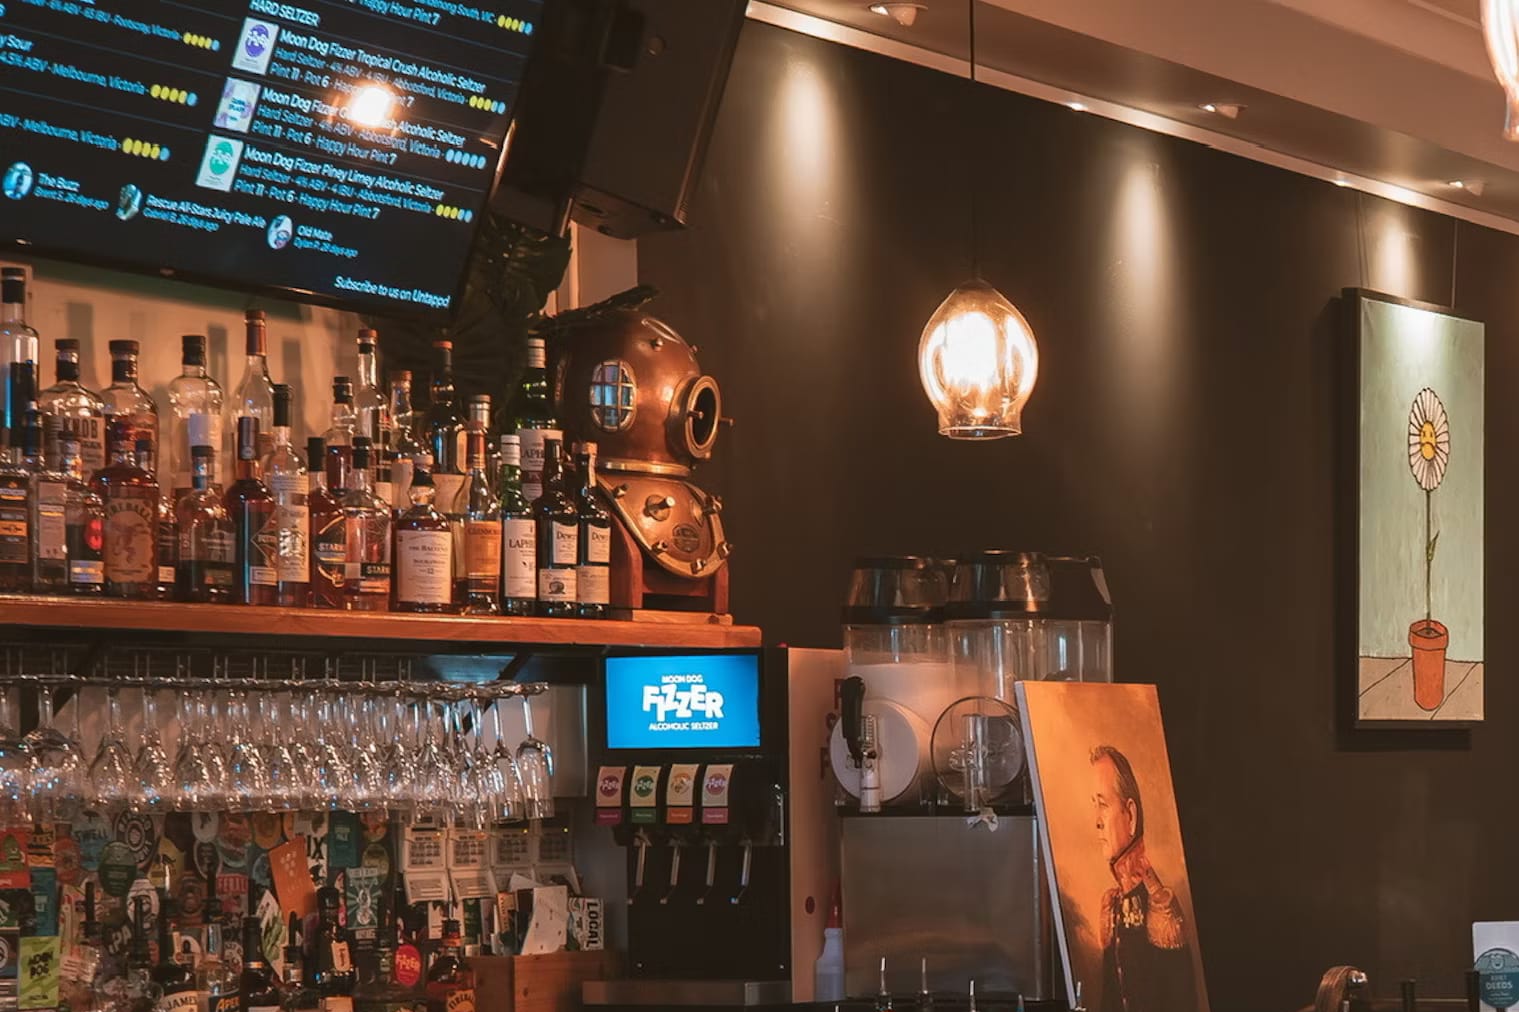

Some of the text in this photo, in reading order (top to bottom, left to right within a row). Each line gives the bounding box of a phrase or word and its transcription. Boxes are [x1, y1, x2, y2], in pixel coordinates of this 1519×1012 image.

[249, 0, 321, 26] HARD SELTZER
[389, 3, 413, 18] Hour
[413, 8, 431, 24] Pint
[431, 13, 440, 26] 7
[274, 47, 297, 61] Hard
[296, 52, 327, 69] Seltzer
[437, 87, 466, 104] Victoria
[280, 29, 307, 49] Moon
[307, 36, 330, 57] Dog
[329, 42, 357, 60] Fizzer
[357, 48, 392, 71] Tropical
[392, 58, 419, 77] Crush
[418, 66, 457, 88] Alcoholic
[457, 76, 487, 95] Seltzer
[108, 76, 145, 95] Victoria
[270, 61, 291, 79] Pint
[303, 70, 322, 86] Pot
[320, 76, 331, 88] 6
[406, 96, 415, 108] 7
[257, 104, 282, 120] Hard
[281, 109, 314, 128] Seltzer
[409, 139, 441, 159] Victoria
[262, 87, 290, 106] Moon
[290, 94, 312, 113] Dog
[311, 99, 339, 117] Fizzer
[397, 121, 438, 140] Alcoholic
[437, 129, 466, 148] Seltzer
[251, 120, 273, 136] Pint
[286, 128, 305, 143] Pot
[303, 132, 314, 145] 6
[316, 135, 347, 156] Happy
[346, 142, 370, 159] Hour
[369, 149, 389, 165] Pint
[388, 153, 398, 165] 7
[239, 163, 262, 178] Hard
[261, 168, 291, 184] Seltzer
[243, 144, 273, 164] Moon
[272, 152, 294, 172] Dog
[294, 158, 322, 174] Fizzer
[321, 163, 348, 182] Piney
[347, 169, 376, 189] Limey
[375, 176, 415, 195] Alcoholic
[414, 184, 445, 200] Seltzer
[233, 178, 256, 195] Pint
[268, 185, 287, 201] Pot
[286, 190, 296, 202] 6
[298, 192, 330, 212] Happy
[329, 199, 353, 215] Hour
[352, 203, 372, 219] Pint
[371, 207, 380, 220] 7
[334, 275, 378, 295] Subscribe
[377, 284, 388, 297] to
[388, 287, 400, 299] us
[400, 289, 412, 301] on
[661, 674, 703, 684] MOON DOG
[642, 683, 724, 722] FIZZER
[649, 721, 719, 731] ALCOHOLIC SELTZER
[586, 902, 600, 948] LOCAL
[1485, 981, 1513, 991] DEEDS
